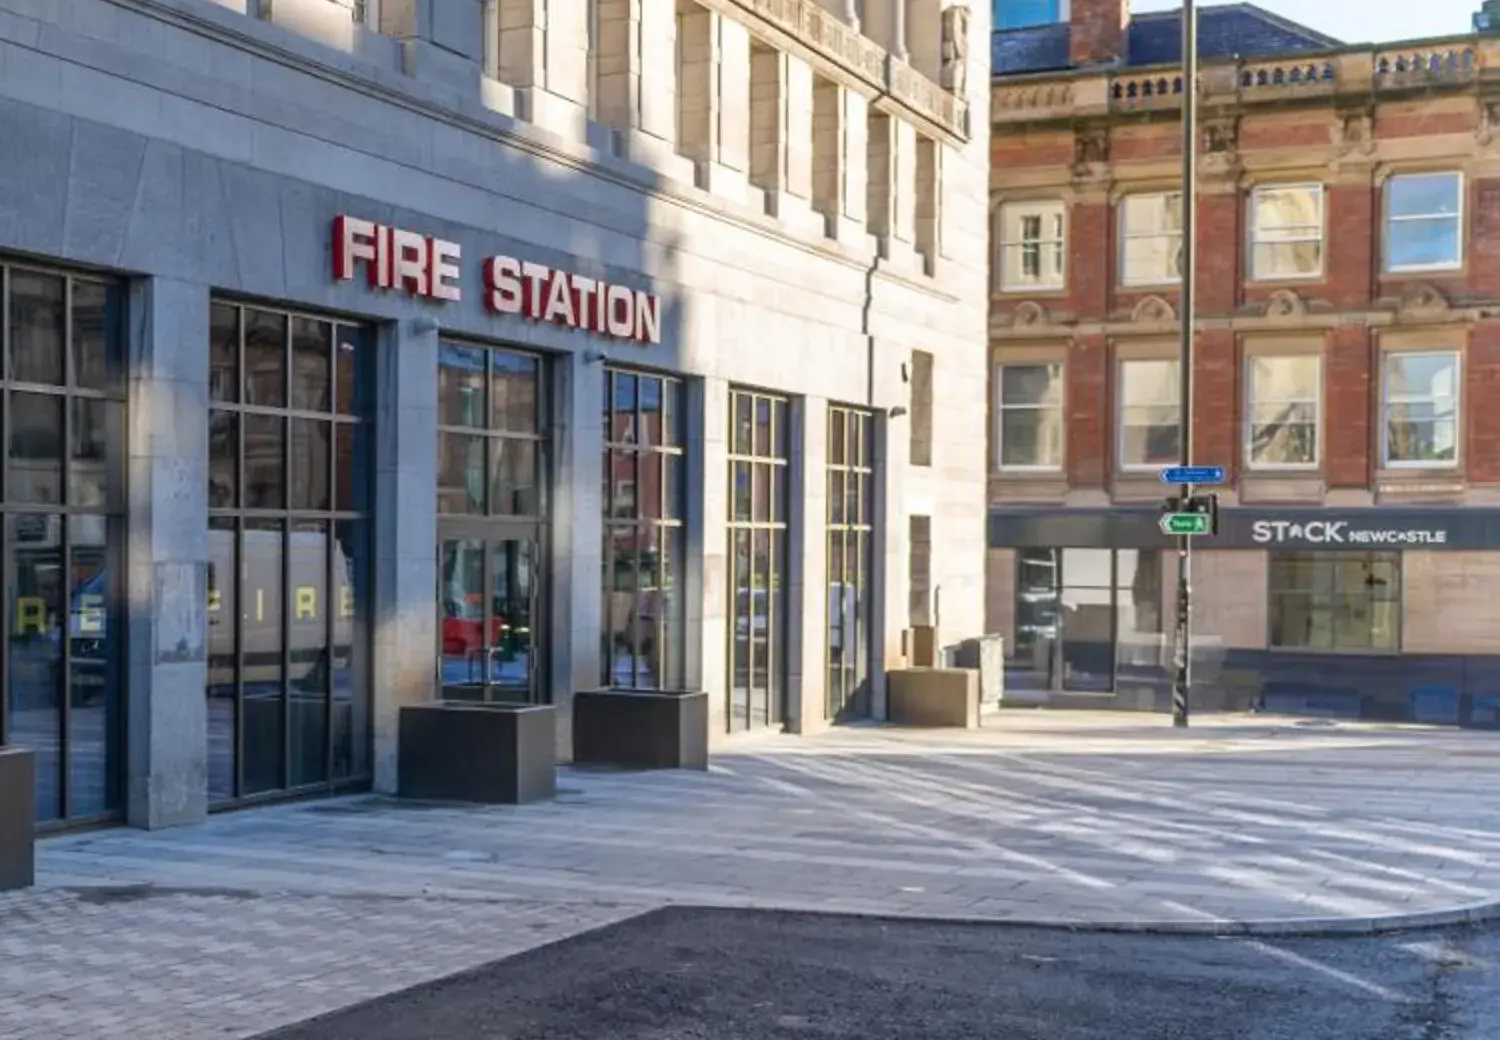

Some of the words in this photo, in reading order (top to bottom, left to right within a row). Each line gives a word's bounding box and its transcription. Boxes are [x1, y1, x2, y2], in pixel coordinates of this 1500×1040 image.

[332, 213, 462, 302] FIRE
[484, 254, 661, 344] STATION
[1349, 529, 1447, 544] NEWCASTLE
